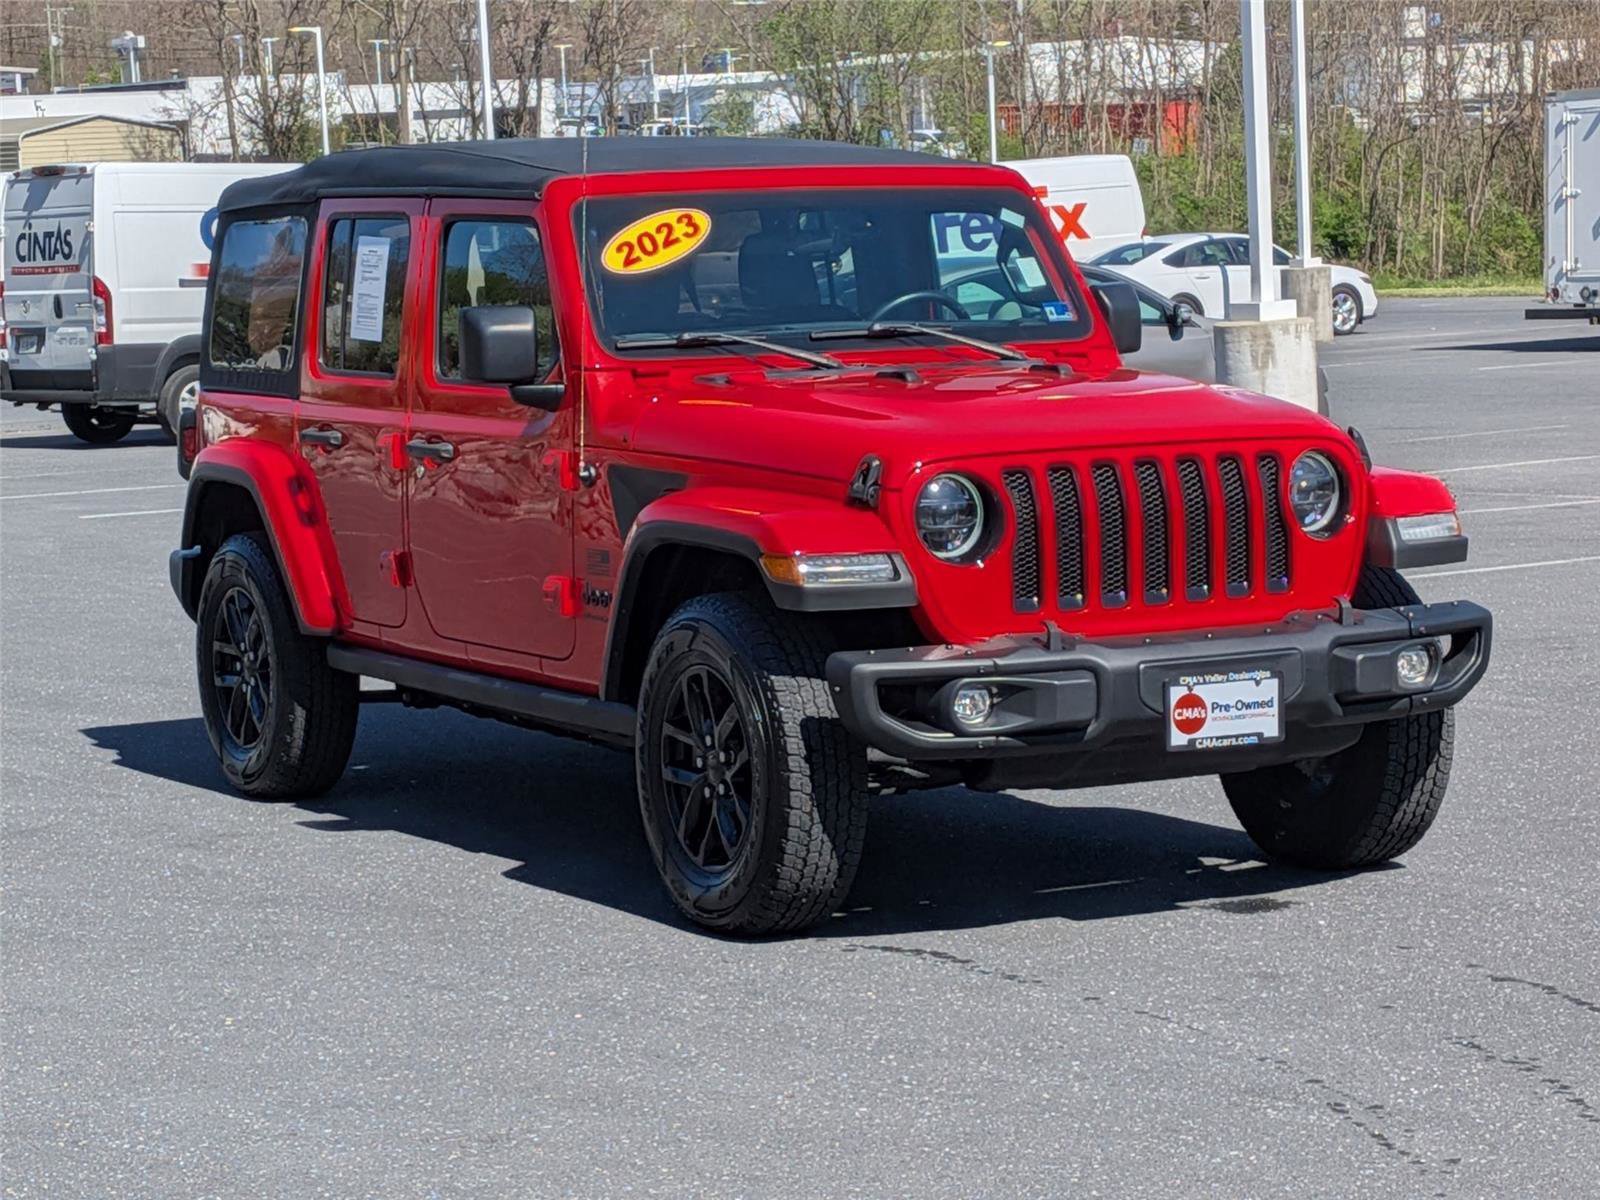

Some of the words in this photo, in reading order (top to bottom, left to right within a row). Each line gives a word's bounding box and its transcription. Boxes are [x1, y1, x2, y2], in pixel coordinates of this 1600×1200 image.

[615, 212, 701, 268] 2023
[1211, 697, 1274, 713] Pre-Owned
[1174, 707, 1206, 720] CMA's
[1195, 736, 1258, 748] CMAcars.com
